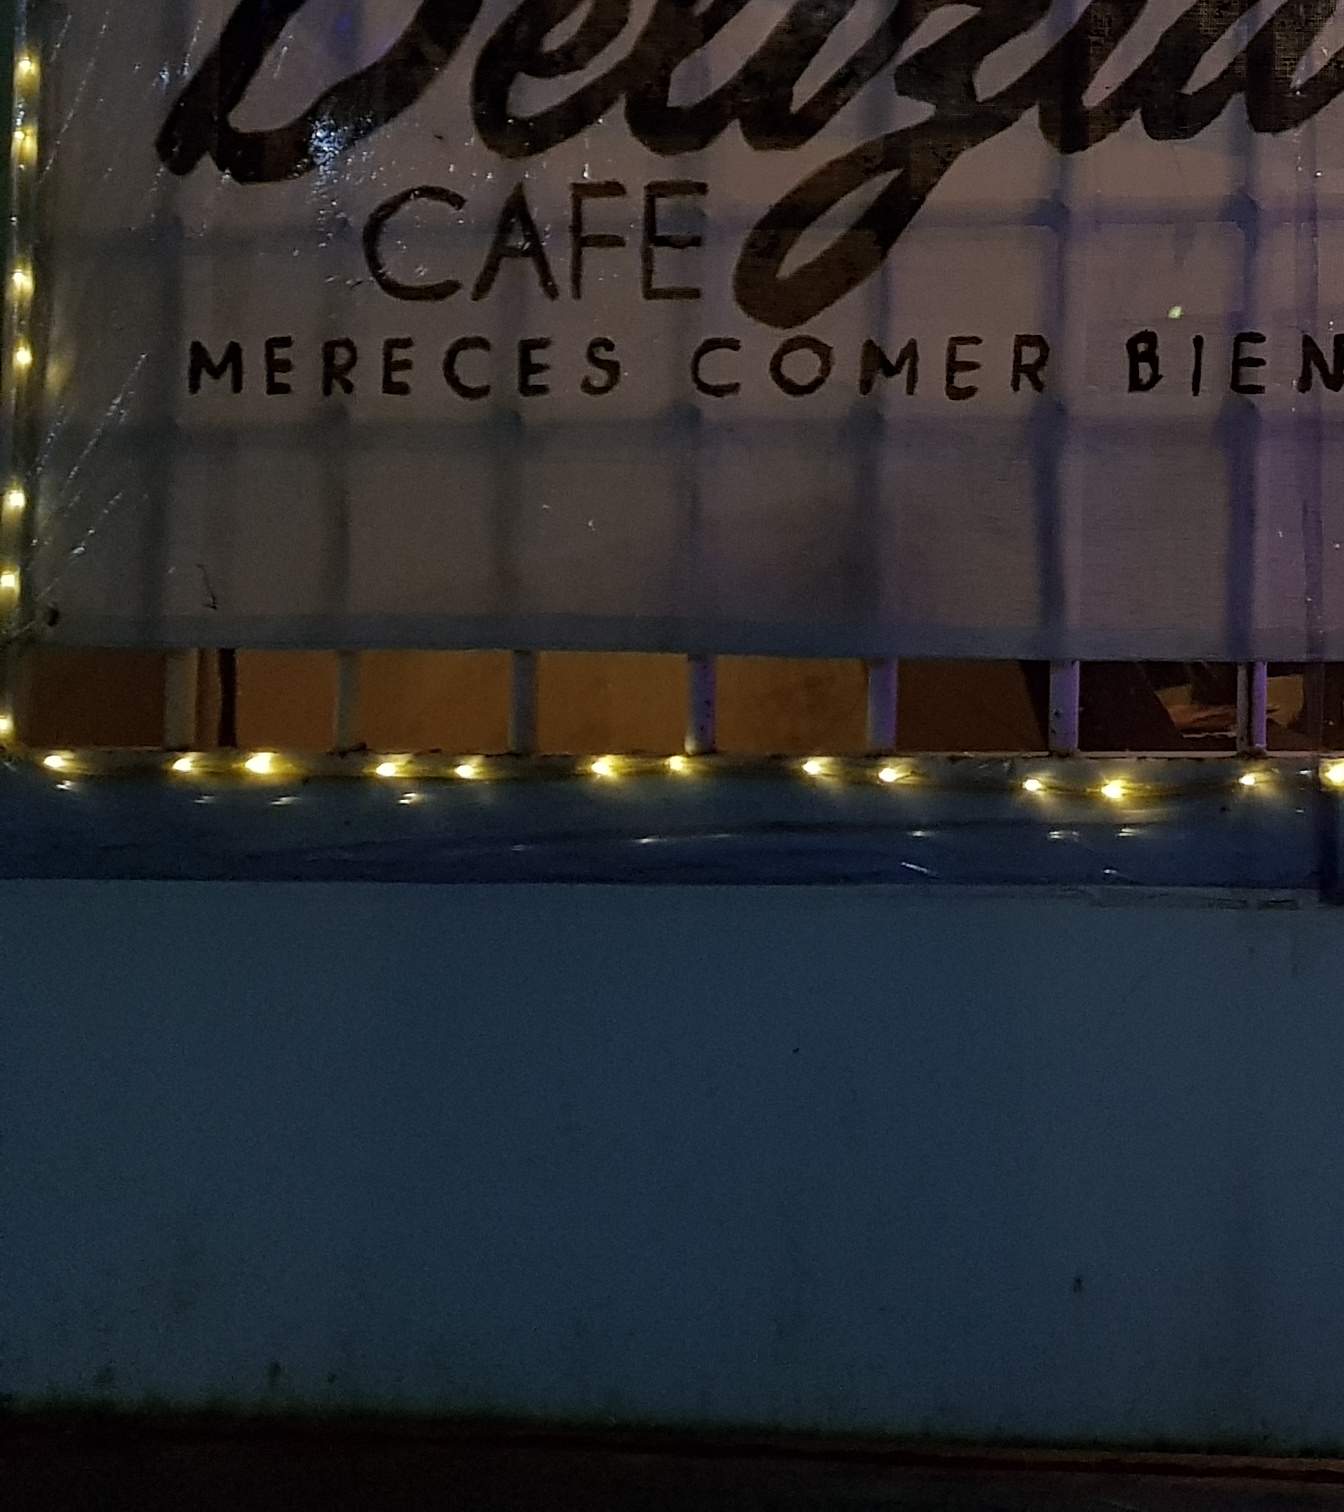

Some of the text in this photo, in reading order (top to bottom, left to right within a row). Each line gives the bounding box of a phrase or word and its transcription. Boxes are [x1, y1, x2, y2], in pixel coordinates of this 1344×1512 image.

[361, 177, 708, 301] CAFE
[188, 333, 624, 398] MERECES
[691, 333, 1050, 400] COMER
